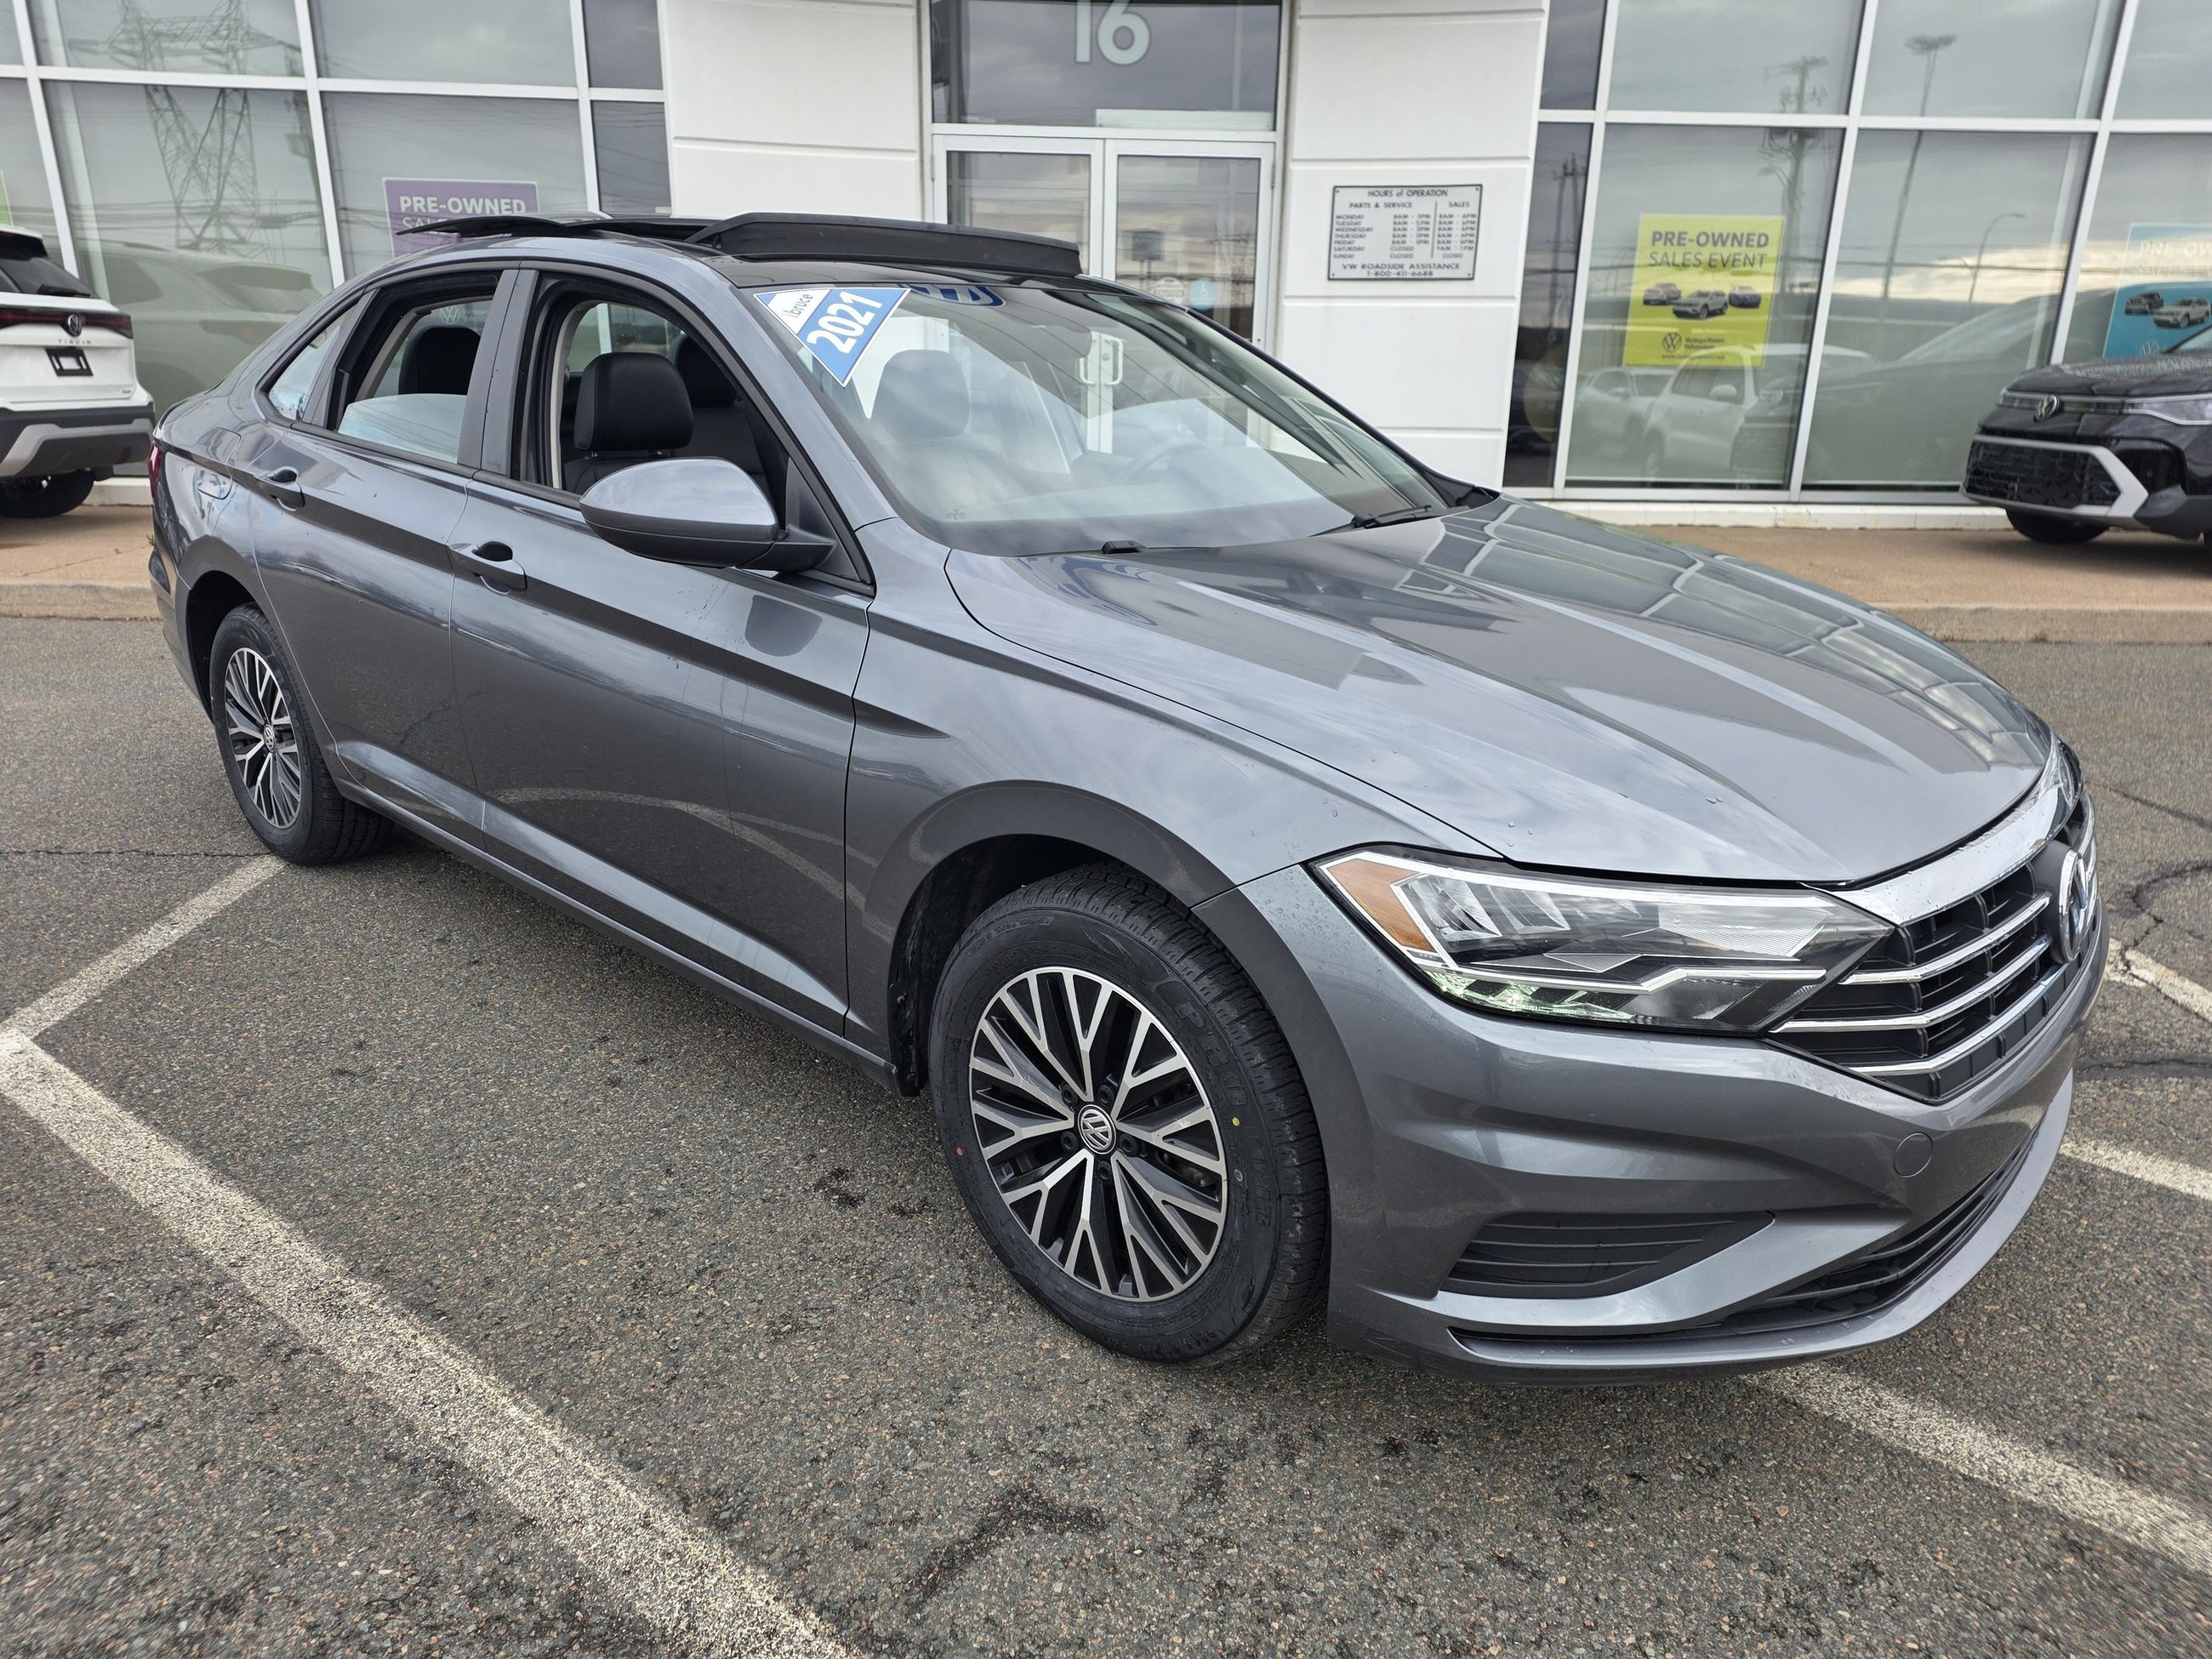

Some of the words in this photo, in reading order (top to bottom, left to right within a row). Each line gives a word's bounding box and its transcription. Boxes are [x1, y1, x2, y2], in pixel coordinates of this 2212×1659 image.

[1075, 0, 1150, 65] 16
[400, 196, 526, 214] PRE-OWNED
[1651, 231, 1770, 248] PRE-OWNED
[1649, 252, 1702, 267] SALES
[1707, 253, 1767, 269] EVENT
[807, 291, 882, 354] 2021
